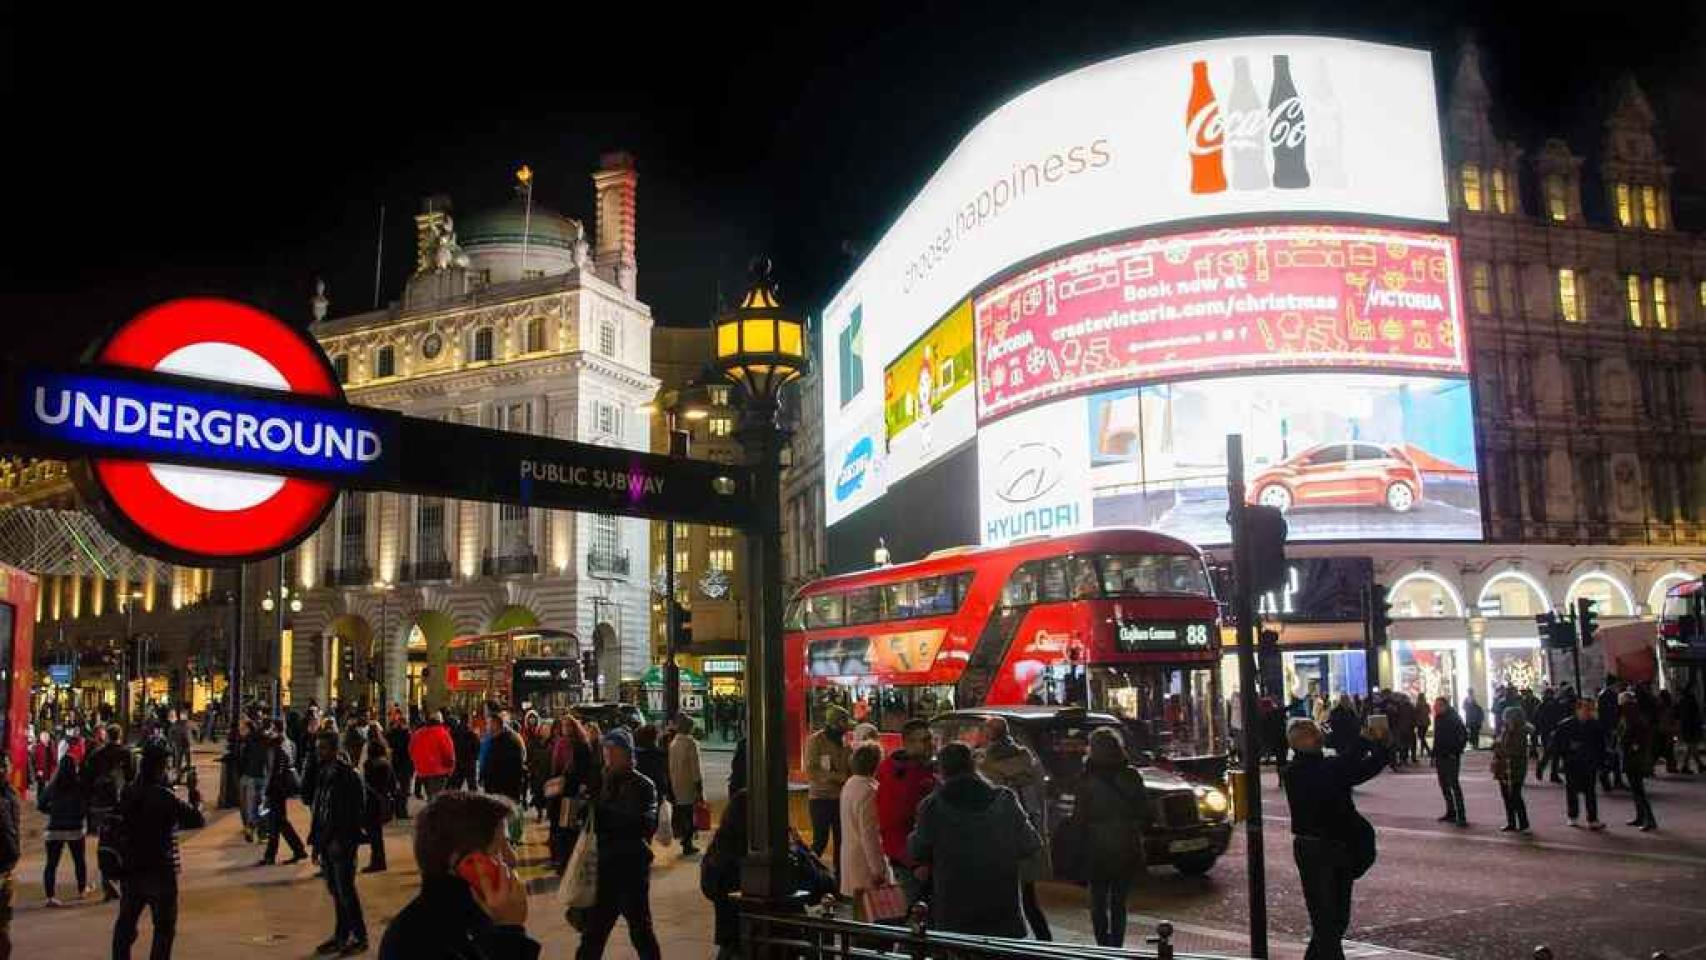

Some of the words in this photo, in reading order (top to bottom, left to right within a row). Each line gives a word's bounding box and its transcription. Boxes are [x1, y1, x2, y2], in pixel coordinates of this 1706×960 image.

[954, 138, 1112, 242] happiness
[1123, 280, 1173, 302] Book
[1177, 276, 1220, 296] now
[1224, 273, 1248, 290] at
[1367, 288, 1443, 312] VICTORIA
[33, 385, 384, 463] UNDERGROUND
[519, 459, 588, 486] PUBLIC
[592, 467, 665, 496] SUBWAY
[987, 501, 1080, 543] HYUNDAI
[1187, 624, 1207, 646] 88
